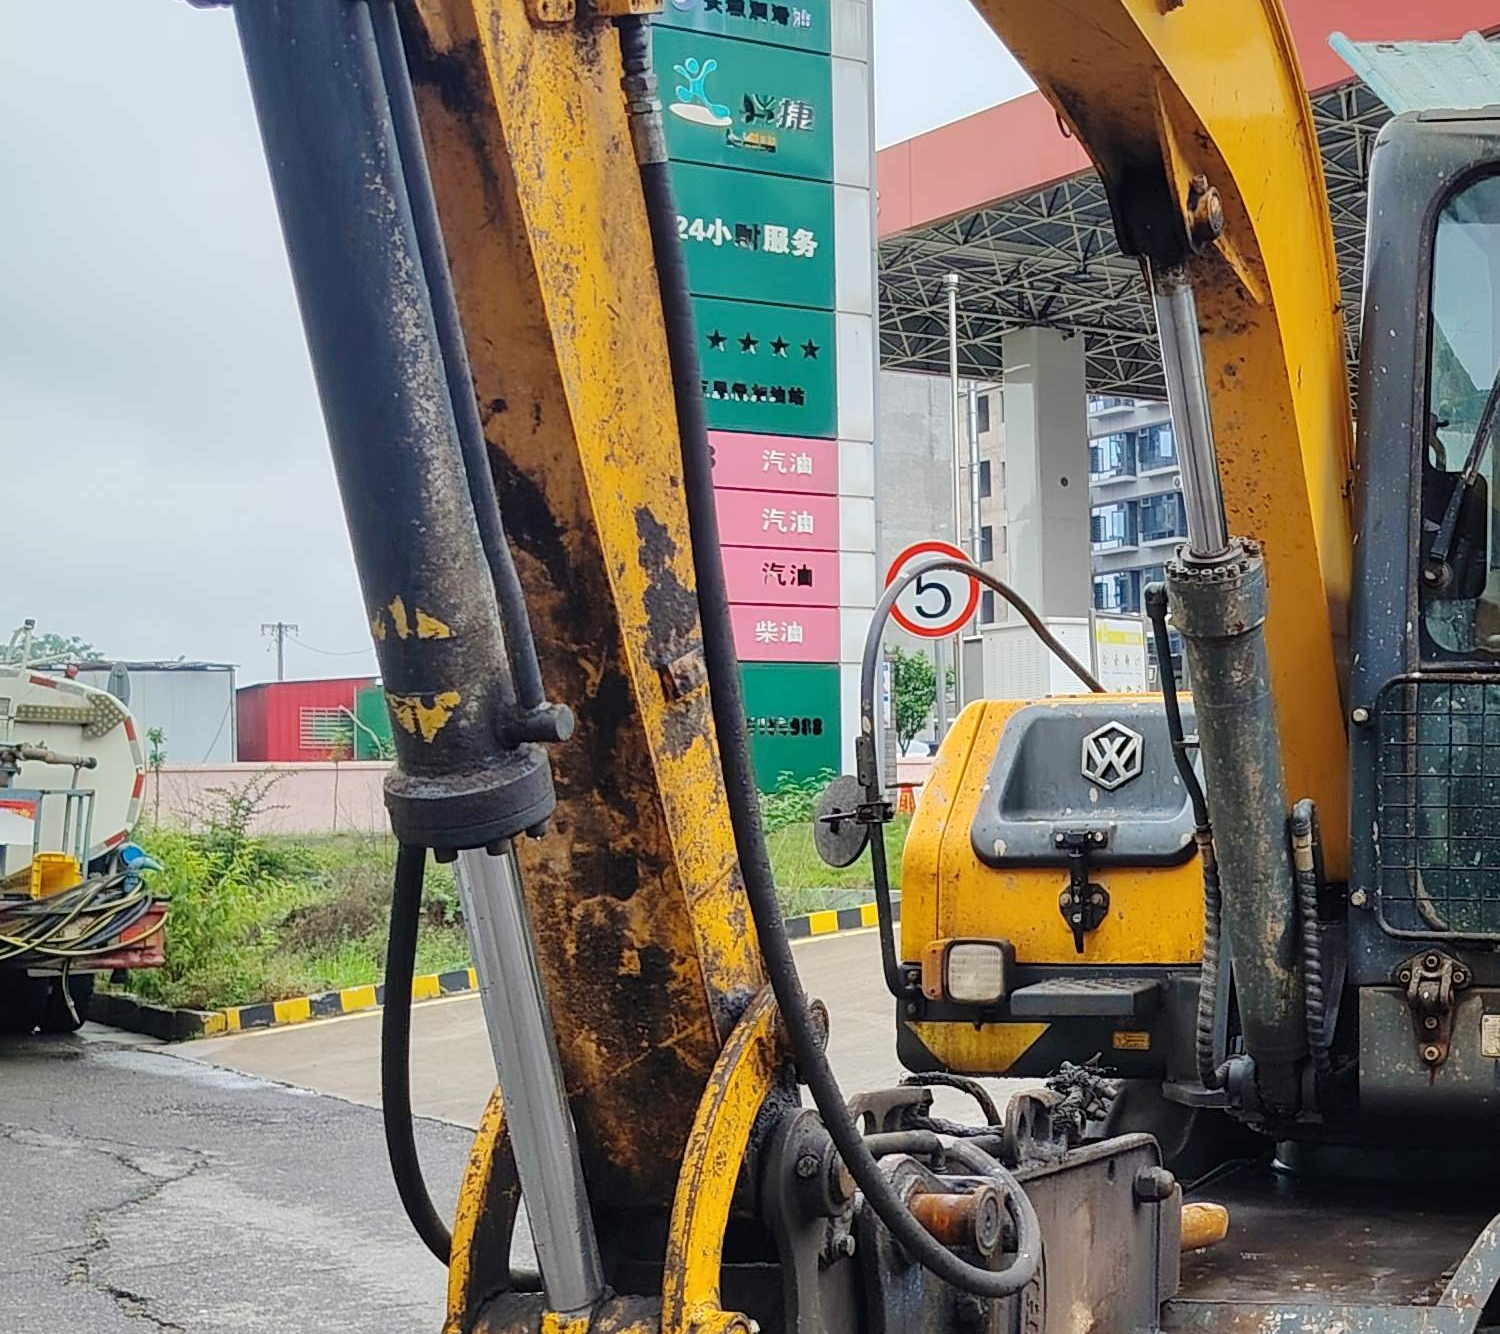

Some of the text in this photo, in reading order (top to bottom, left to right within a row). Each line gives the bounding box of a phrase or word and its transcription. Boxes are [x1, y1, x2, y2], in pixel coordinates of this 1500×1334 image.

[762, 450, 813, 475] 汽油
[761, 508, 814, 534] 汽油
[762, 563, 813, 587] 汽油
[915, 574, 952, 619] 5
[755, 621, 803, 644] 柴油
